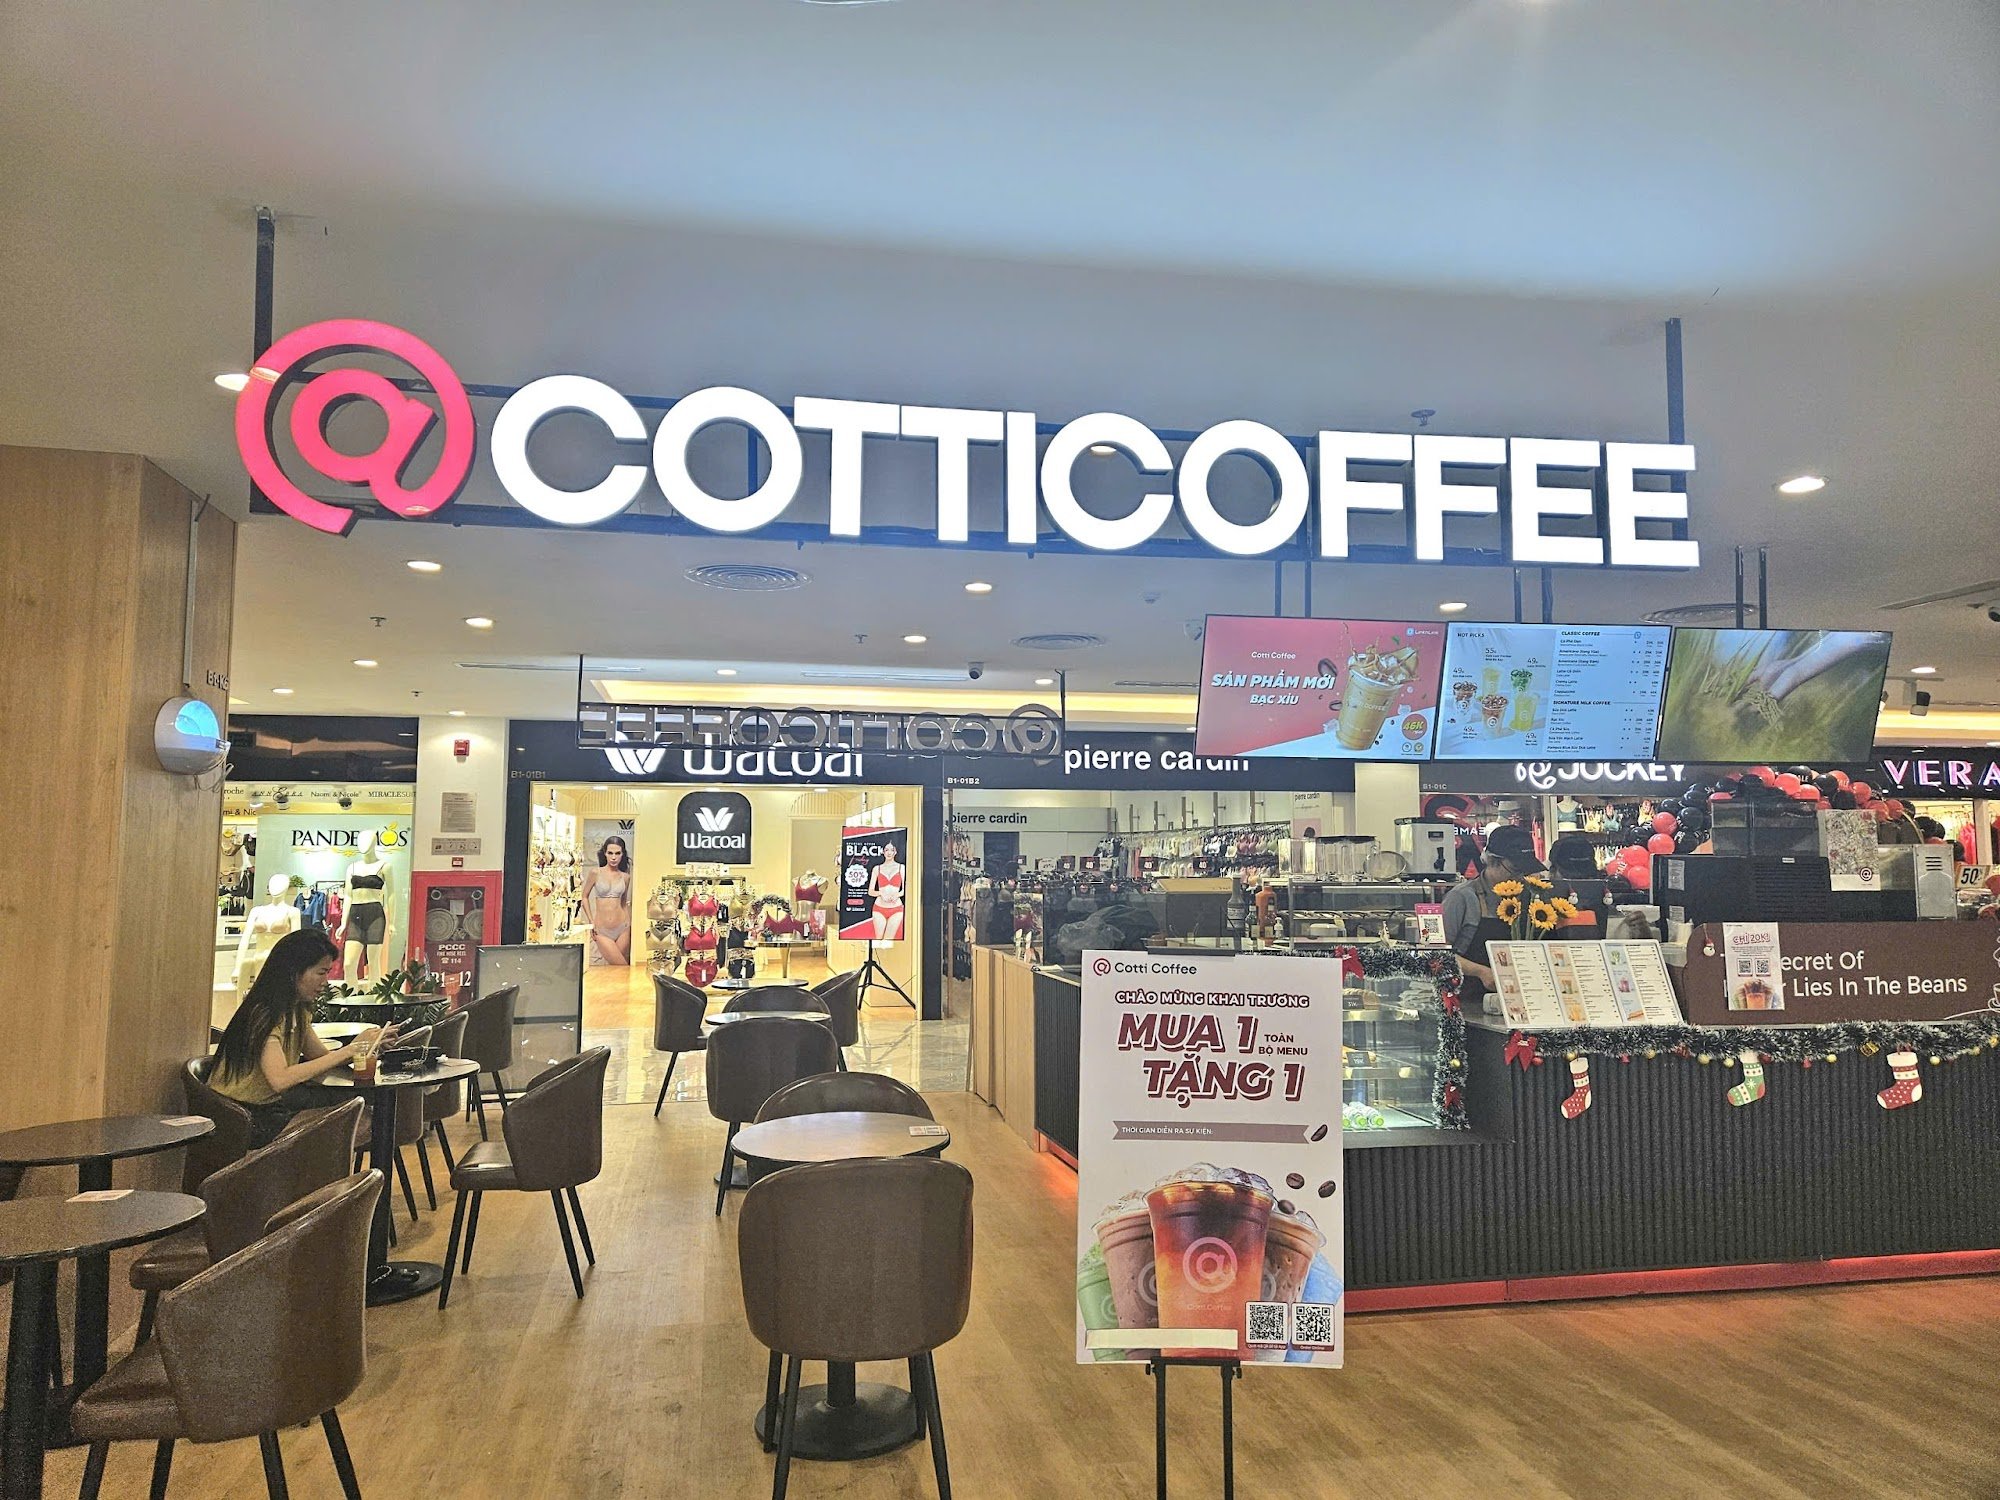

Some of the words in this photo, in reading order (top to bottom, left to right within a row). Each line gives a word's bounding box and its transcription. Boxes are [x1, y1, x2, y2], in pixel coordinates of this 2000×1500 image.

[1251, 651, 1270, 659] Cotti
[1271, 652, 1296, 660] Coffee
[1211, 670, 1246, 688] SẢN
[1250, 669, 1299, 690] PHẨM
[1302, 674, 1337, 690] MỚI
[1250, 694, 1274, 707] BẠC
[1064, 745, 1151, 774] pierre
[511, 770, 546, 779] B1-01B1
[1558, 763, 1684, 782] JOCKEY
[947, 777, 980, 785] B1-01B2
[950, 812, 986, 827] pierre
[989, 812, 1028, 824] cardin
[684, 833, 746, 849] Wacoal
[846, 845, 884, 856] BLACK
[1114, 962, 1148, 975] Cotti
[1151, 963, 1197, 975] Coffee
[1781, 954, 1833, 971] ecret
[1839, 950, 1865, 970] Of
[458, 970, 472, 987] 12
[1793, 978, 1832, 997] Lies
[1839, 978, 1858, 996] In
[1863, 976, 1902, 995] The
[1907, 976, 1967, 994] Beans
[1115, 988, 1158, 1005] CHÀO
[1160, 989, 1205, 1006] MỪNG
[1207, 993, 1245, 1007] KHAI
[1247, 994, 1310, 1008] TRƯƠNG
[1117, 1012, 1226, 1053] MUA
[1236, 1015, 1259, 1054] 1
[1264, 1031, 1294, 1044] TOÀN
[1258, 1044, 1274, 1058] BỘ
[1276, 1046, 1308, 1056] MENU
[1143, 1053, 1276, 1109] TẶNG
[1283, 1063, 1306, 1102] 1
